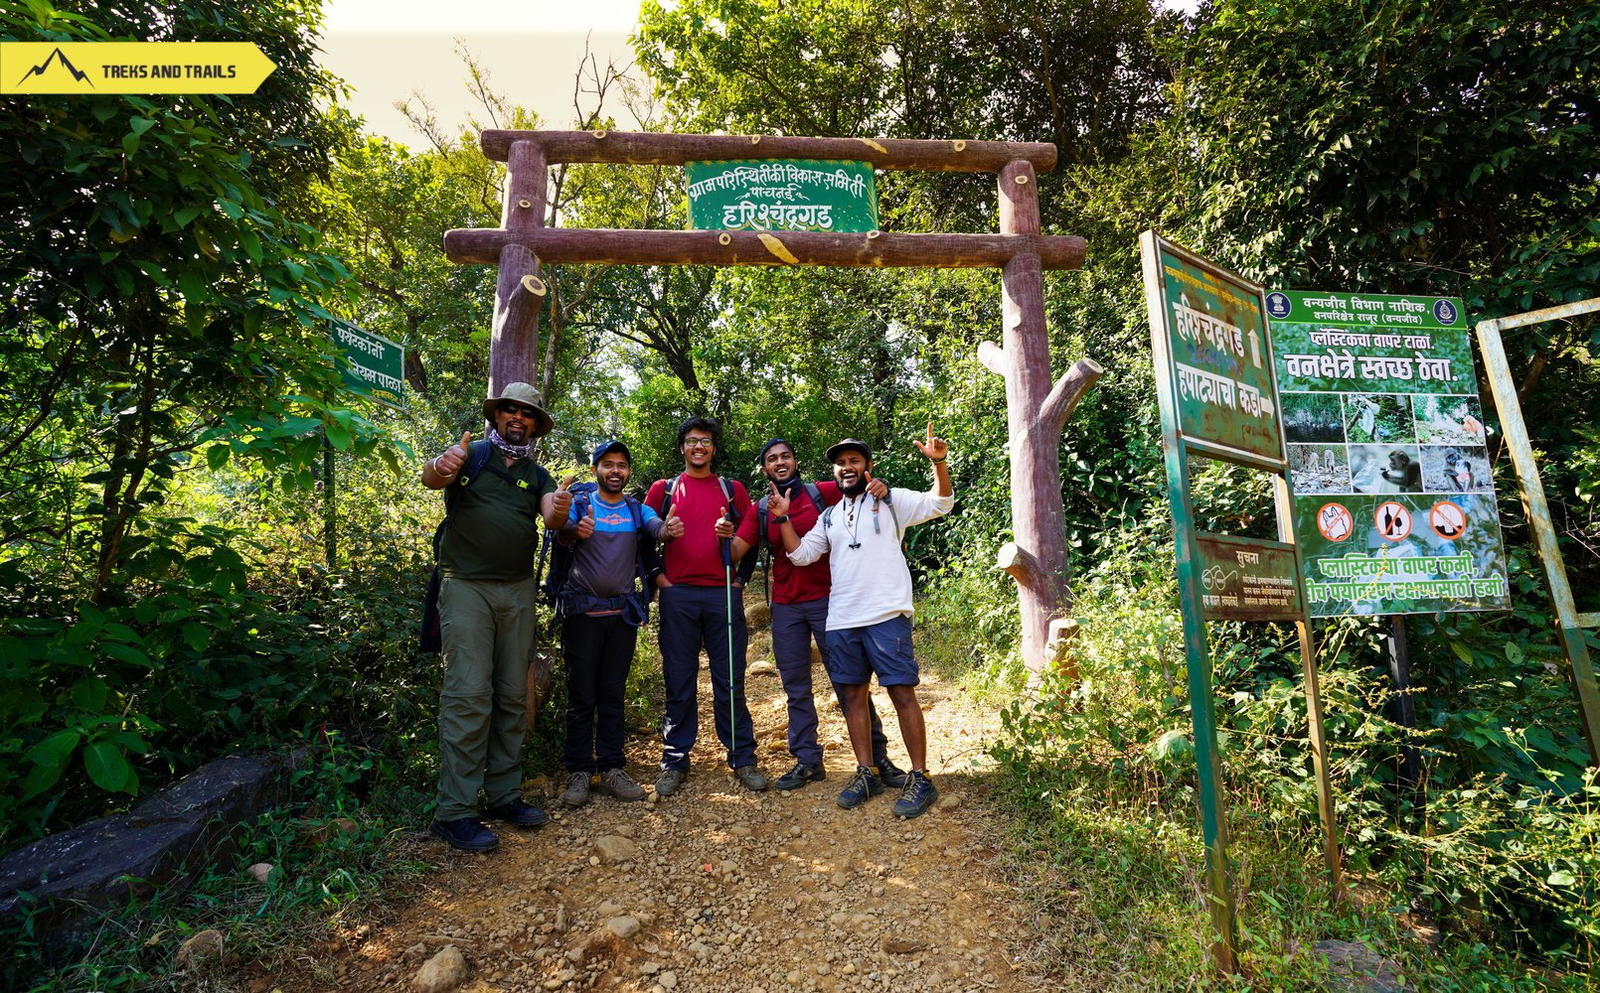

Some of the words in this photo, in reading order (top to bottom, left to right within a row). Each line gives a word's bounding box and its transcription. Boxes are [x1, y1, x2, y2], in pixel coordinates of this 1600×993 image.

[785, 164, 824, 187] विकास
[823, 169, 866, 199] समिती
[722, 200, 833, 231] हरिश्चंद्रगड
[1302, 296, 1346, 310] वन्यजीव
[1351, 297, 1384, 311] विभाग
[1313, 310, 1354, 321] वनपरिक्षेत्र
[1357, 313, 1378, 326] राजूर
[1382, 313, 1423, 325] (वन्यजीव)
[1371, 334, 1401, 348] वापर
[1283, 348, 1356, 380] वनक्षेत्रे
[1357, 355, 1413, 380] स्वच्छ
[1414, 351, 1459, 381] ठेवा.
[376, 371, 402, 393] पाळा
[1399, 556, 1437, 575] वापर
[1472, 573, 1504, 597] हमी
